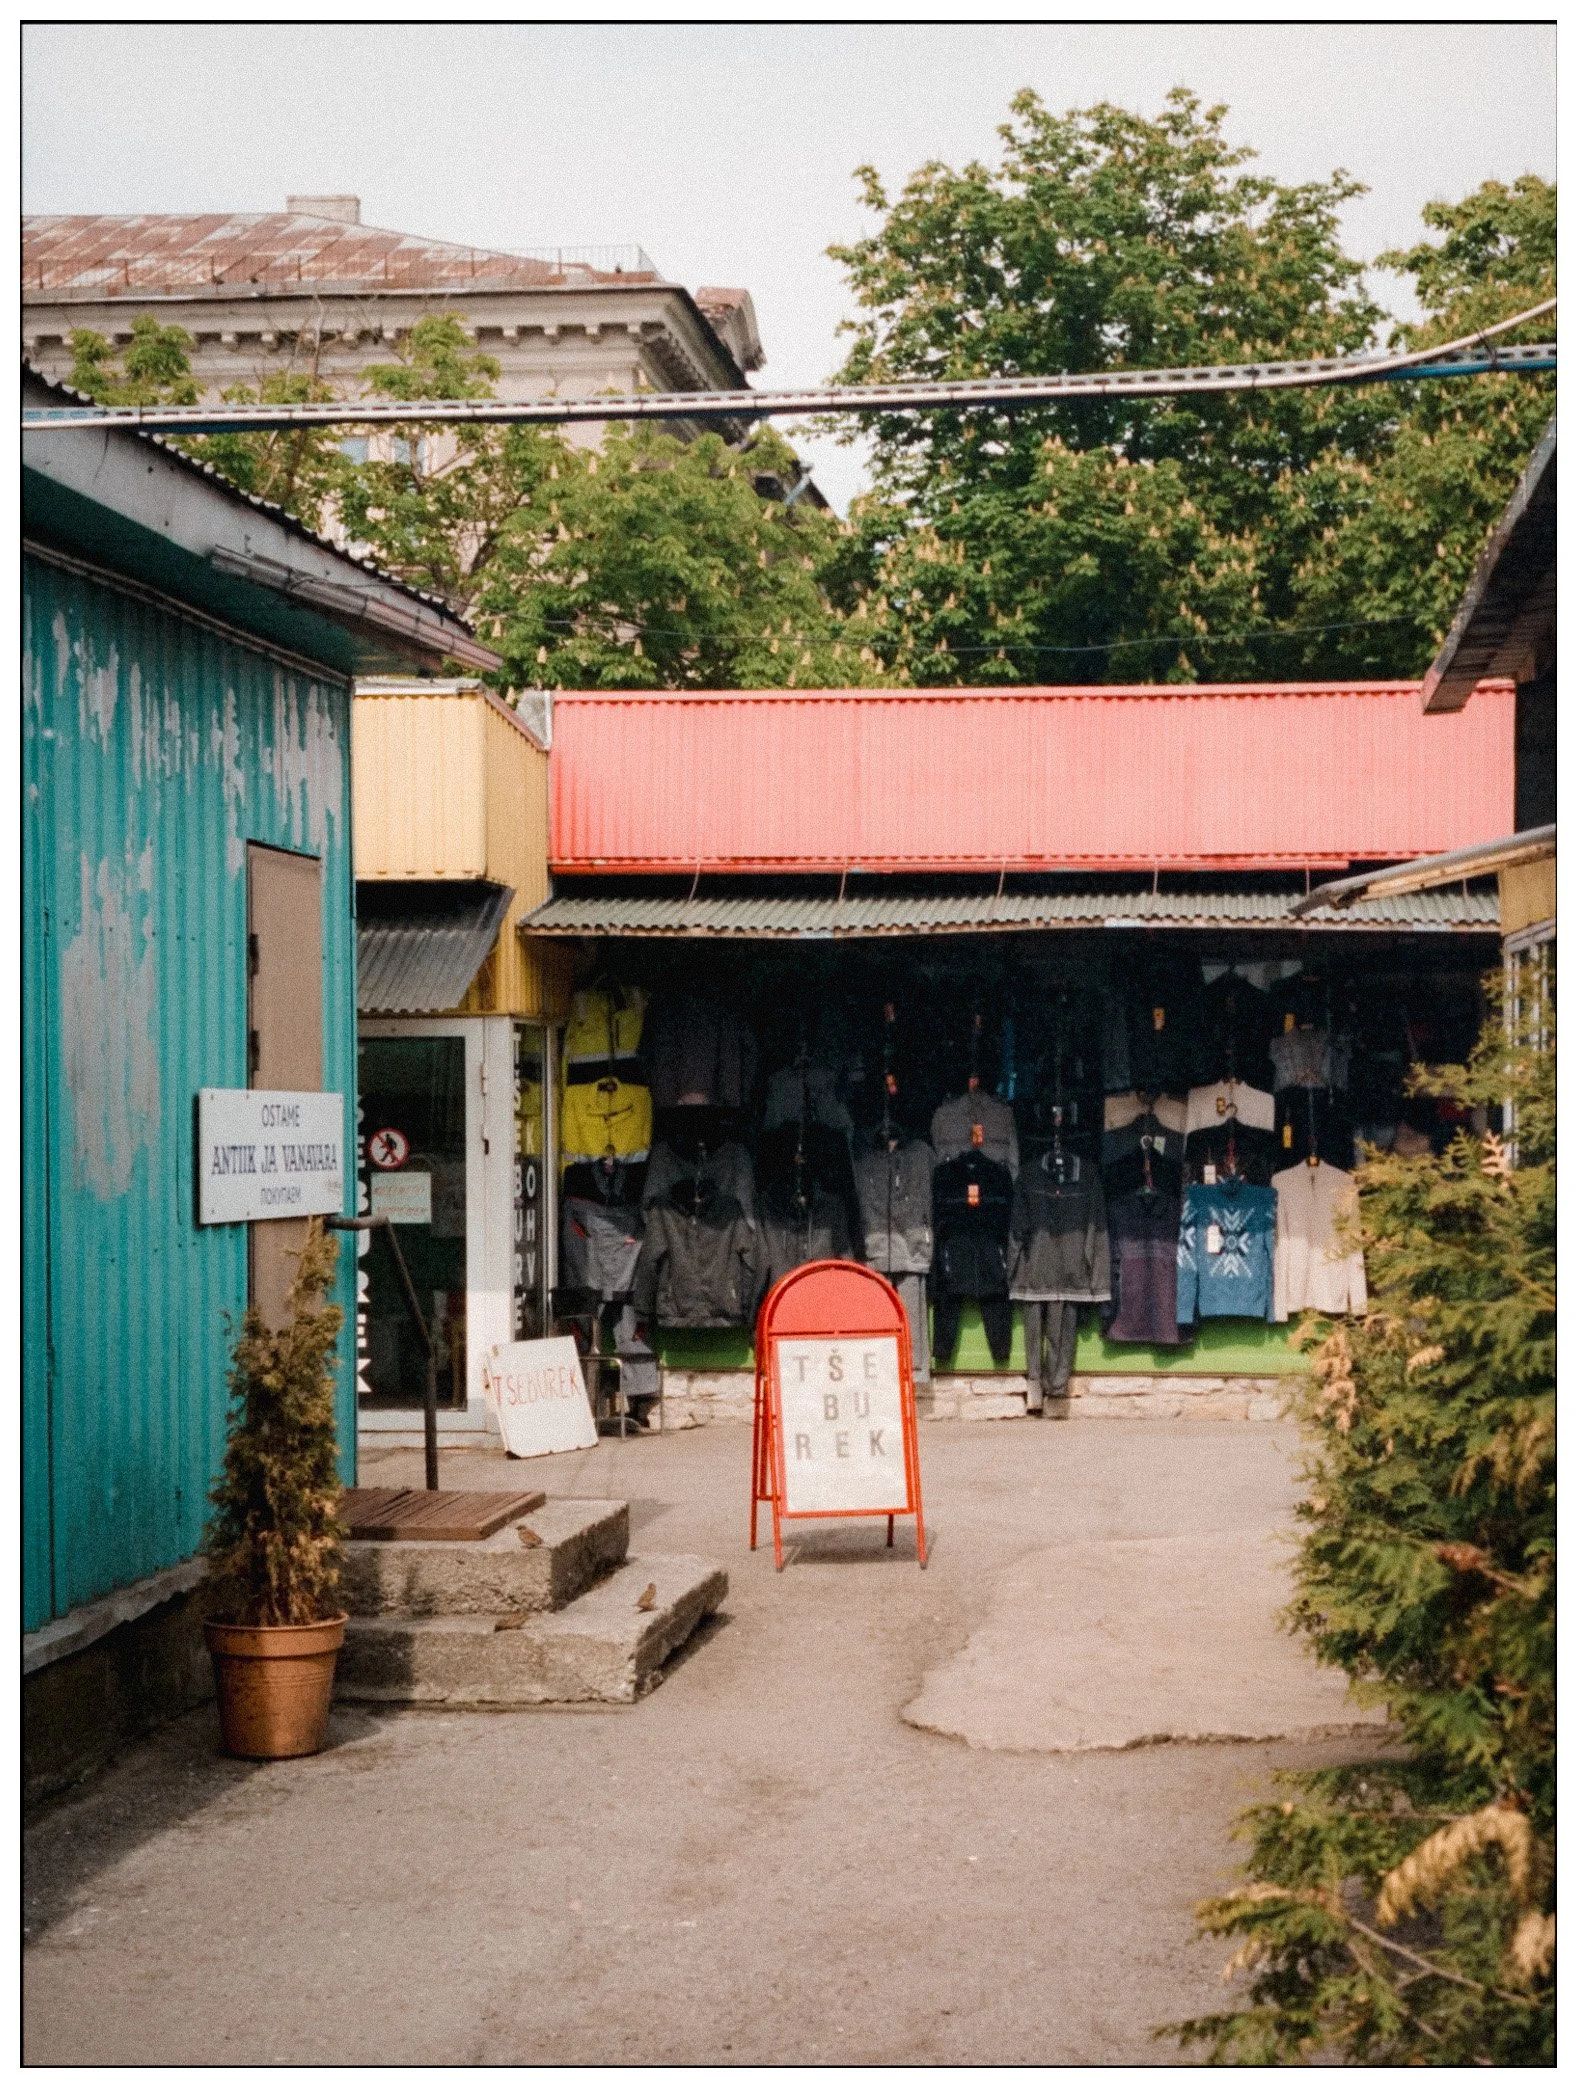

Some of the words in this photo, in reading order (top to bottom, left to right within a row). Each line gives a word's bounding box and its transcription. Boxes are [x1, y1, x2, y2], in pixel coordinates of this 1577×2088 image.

[261, 1104, 301, 1127] OSTAME
[212, 1145, 256, 1175] ANTIIK
[261, 1145, 278, 1173] JA
[282, 1143, 337, 1172] VANAVARA
